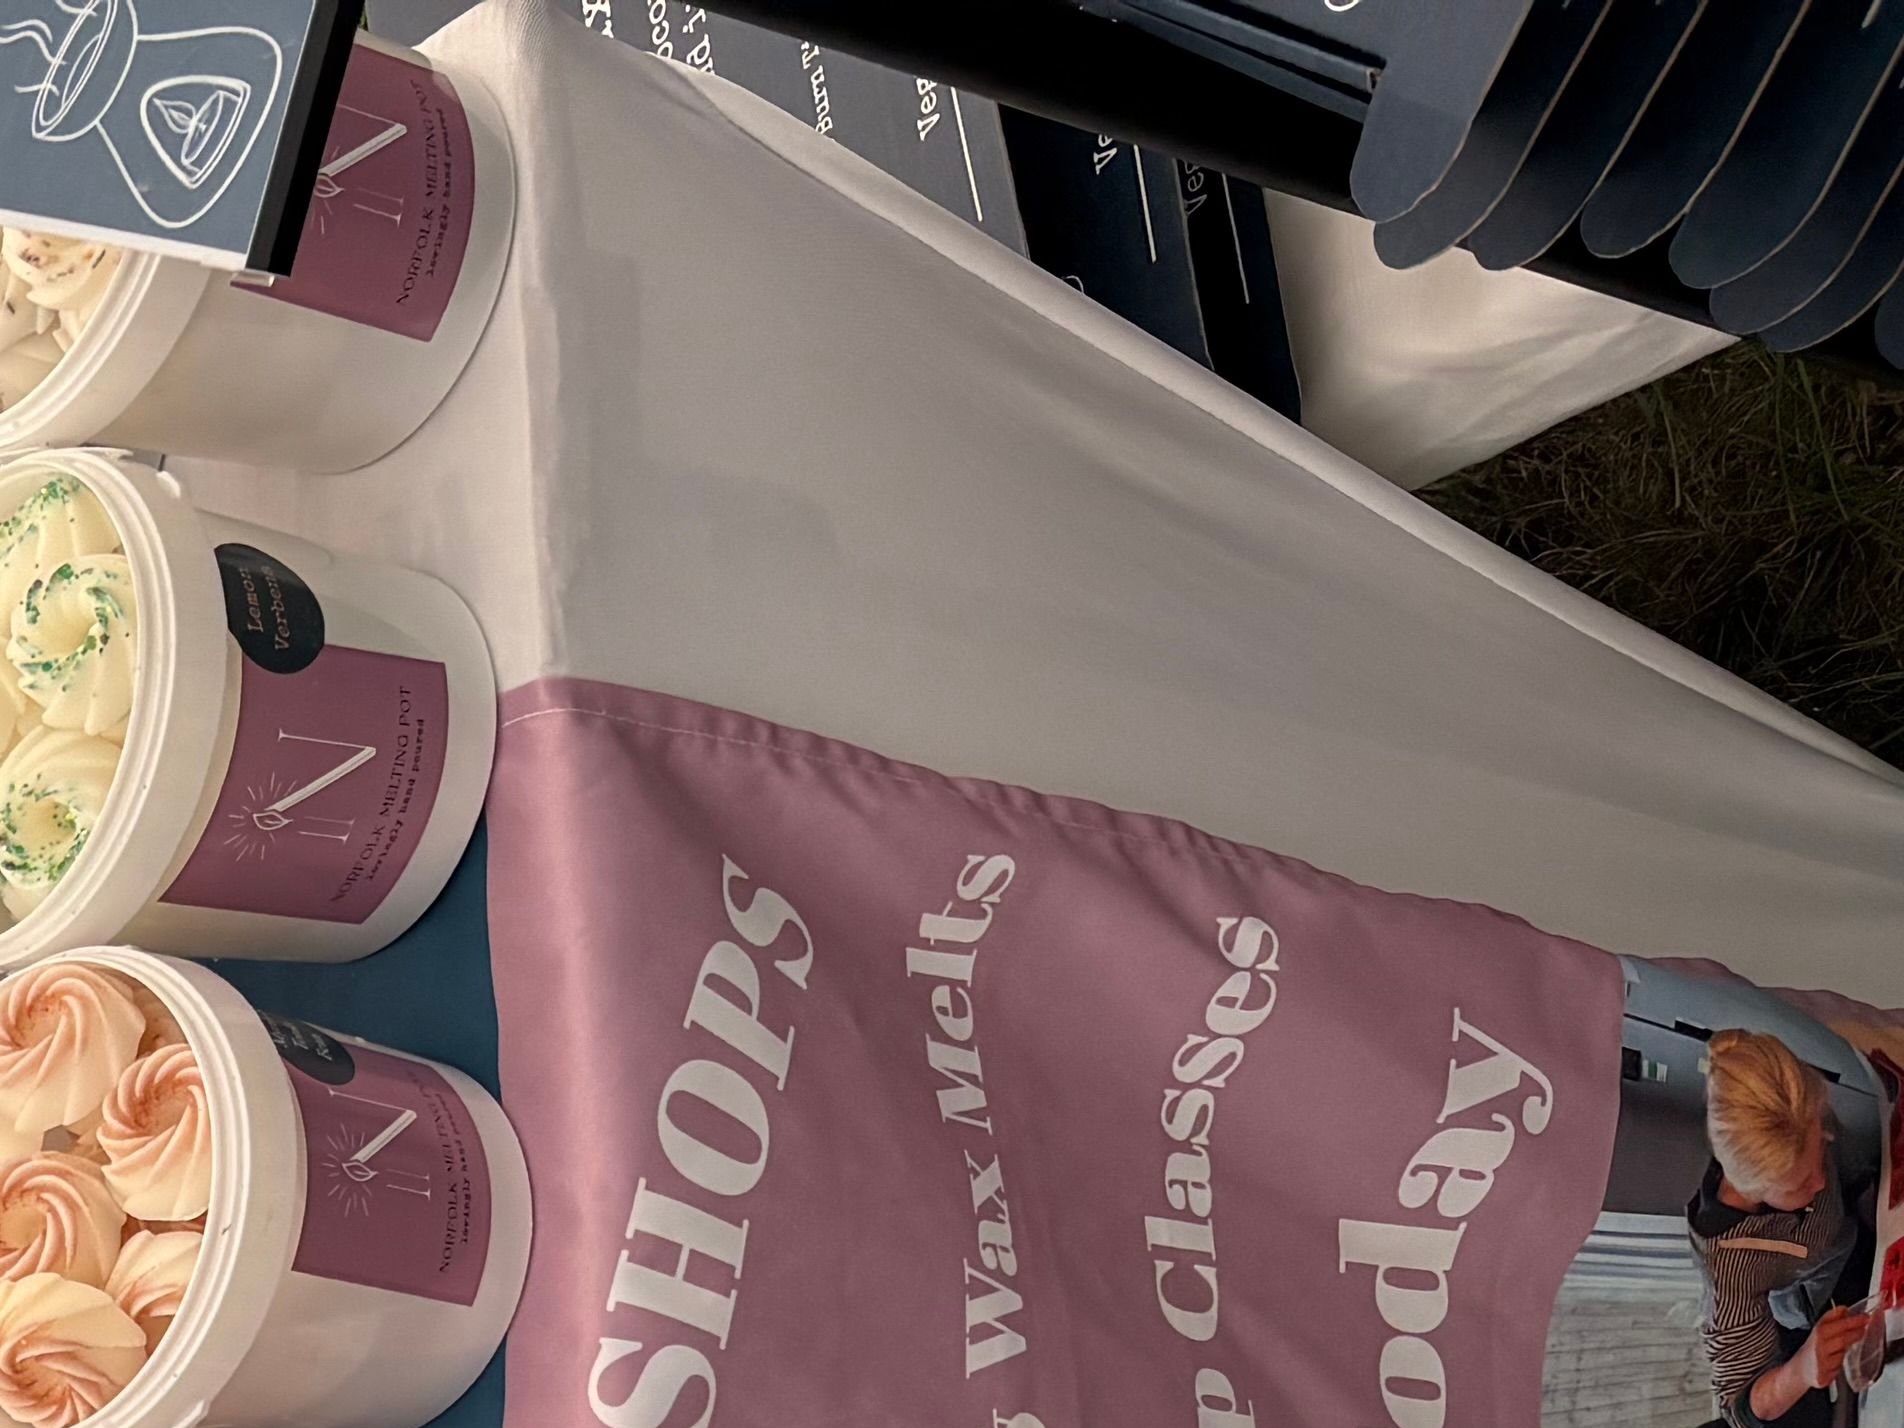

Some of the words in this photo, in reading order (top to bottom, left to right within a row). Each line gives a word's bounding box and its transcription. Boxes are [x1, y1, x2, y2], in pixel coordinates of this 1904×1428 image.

[395, 209, 433, 306] NORFOLK
[421, 118, 437, 197] MELTING
[238, 567, 264, 633] Lemon
[329, 825, 385, 903] NORFOLK
[378, 734, 410, 816] MELTING
[397, 684, 413, 726] POT
[904, 853, 1016, 1137] Melts
[438, 1183, 459, 1273] NORFOLK
[1143, 914, 1280, 1342] Classes
[960, 1150, 1028, 1379] Wax
